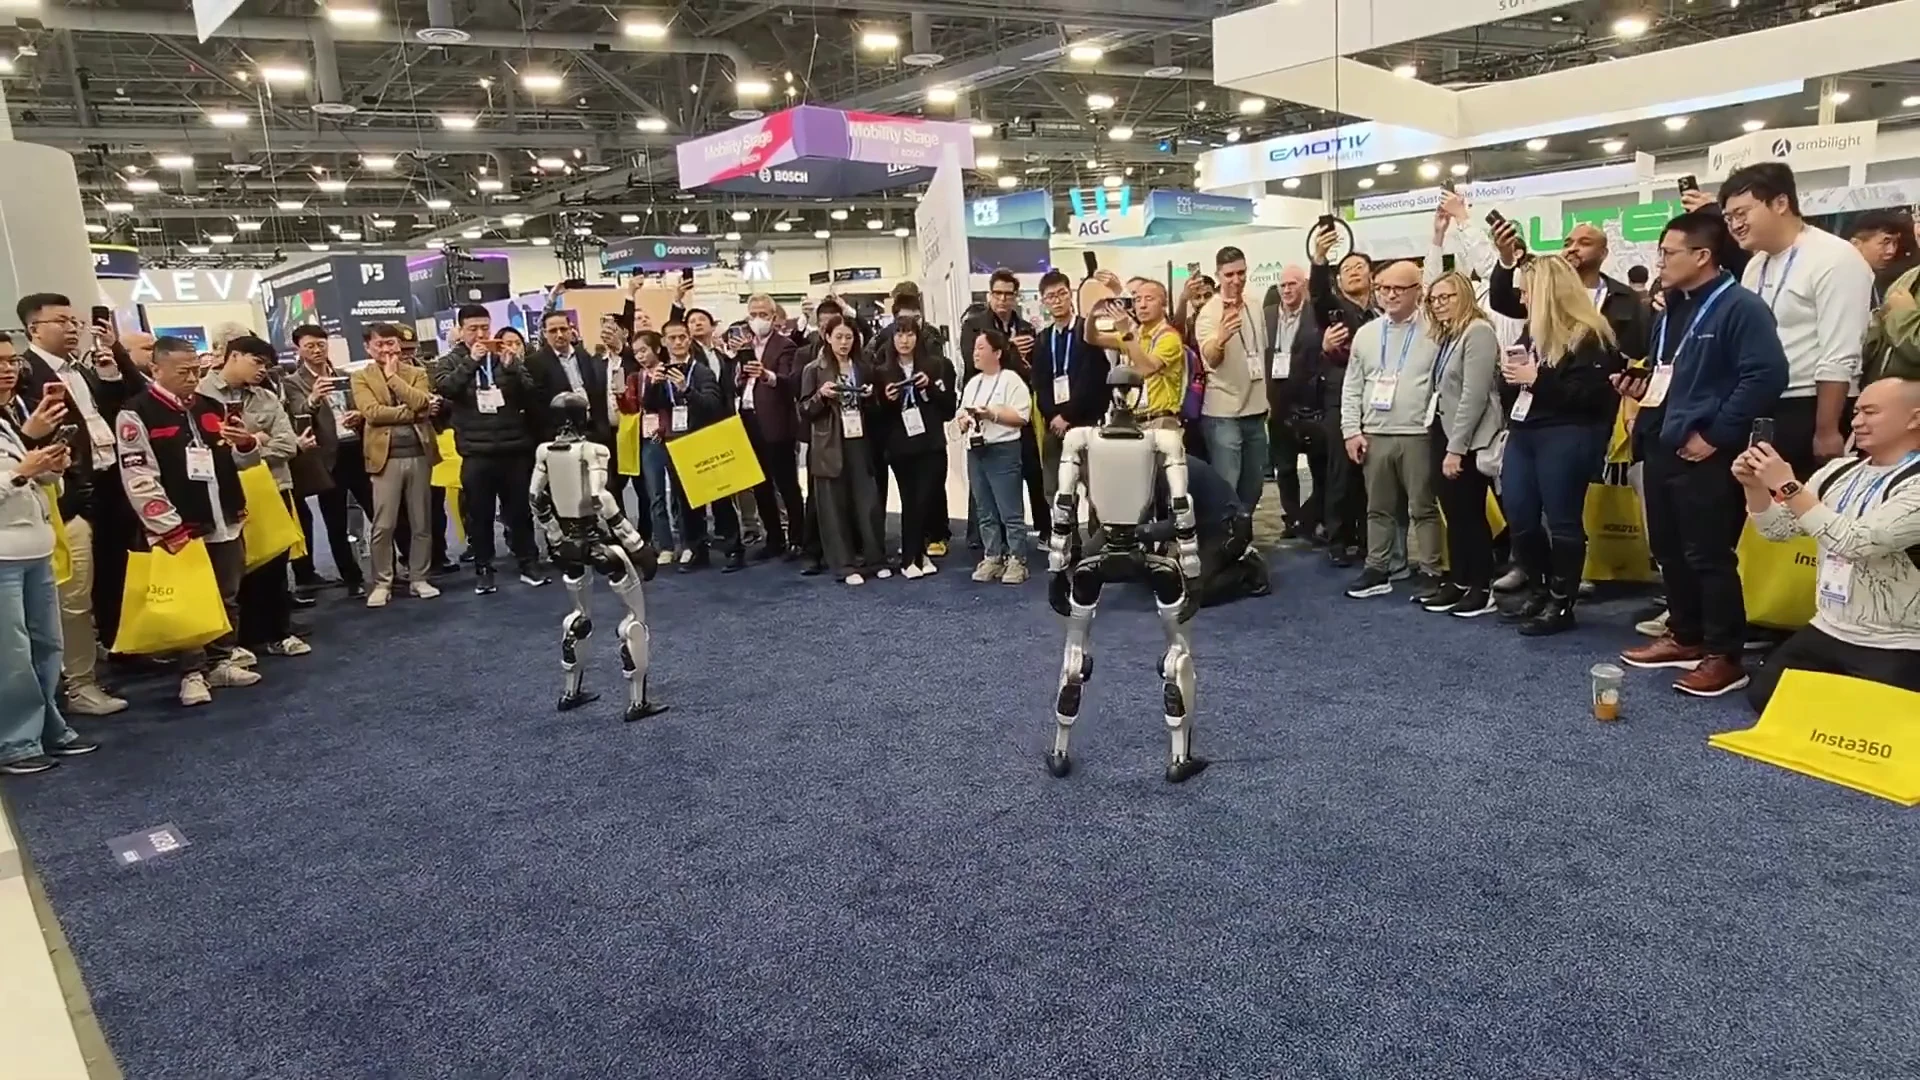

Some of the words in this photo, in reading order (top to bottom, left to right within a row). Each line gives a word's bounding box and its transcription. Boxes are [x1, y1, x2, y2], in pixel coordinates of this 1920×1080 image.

[743, 130, 773, 149] Stage
[850, 123, 901, 144] Mobility
[903, 128, 940, 147] Stage
[1796, 135, 1861, 150] ambilight
[1269, 132, 1371, 162] EMOTIV
[773, 170, 809, 183] BOSCH
[1359, 197, 1416, 212] Accelerating
[1475, 185, 1517, 199] Mobility
[1078, 219, 1110, 237] AGC
[1490, 199, 1683, 253] UTE
[360, 263, 385, 284] P3
[1809, 728, 1893, 759] Insta360
